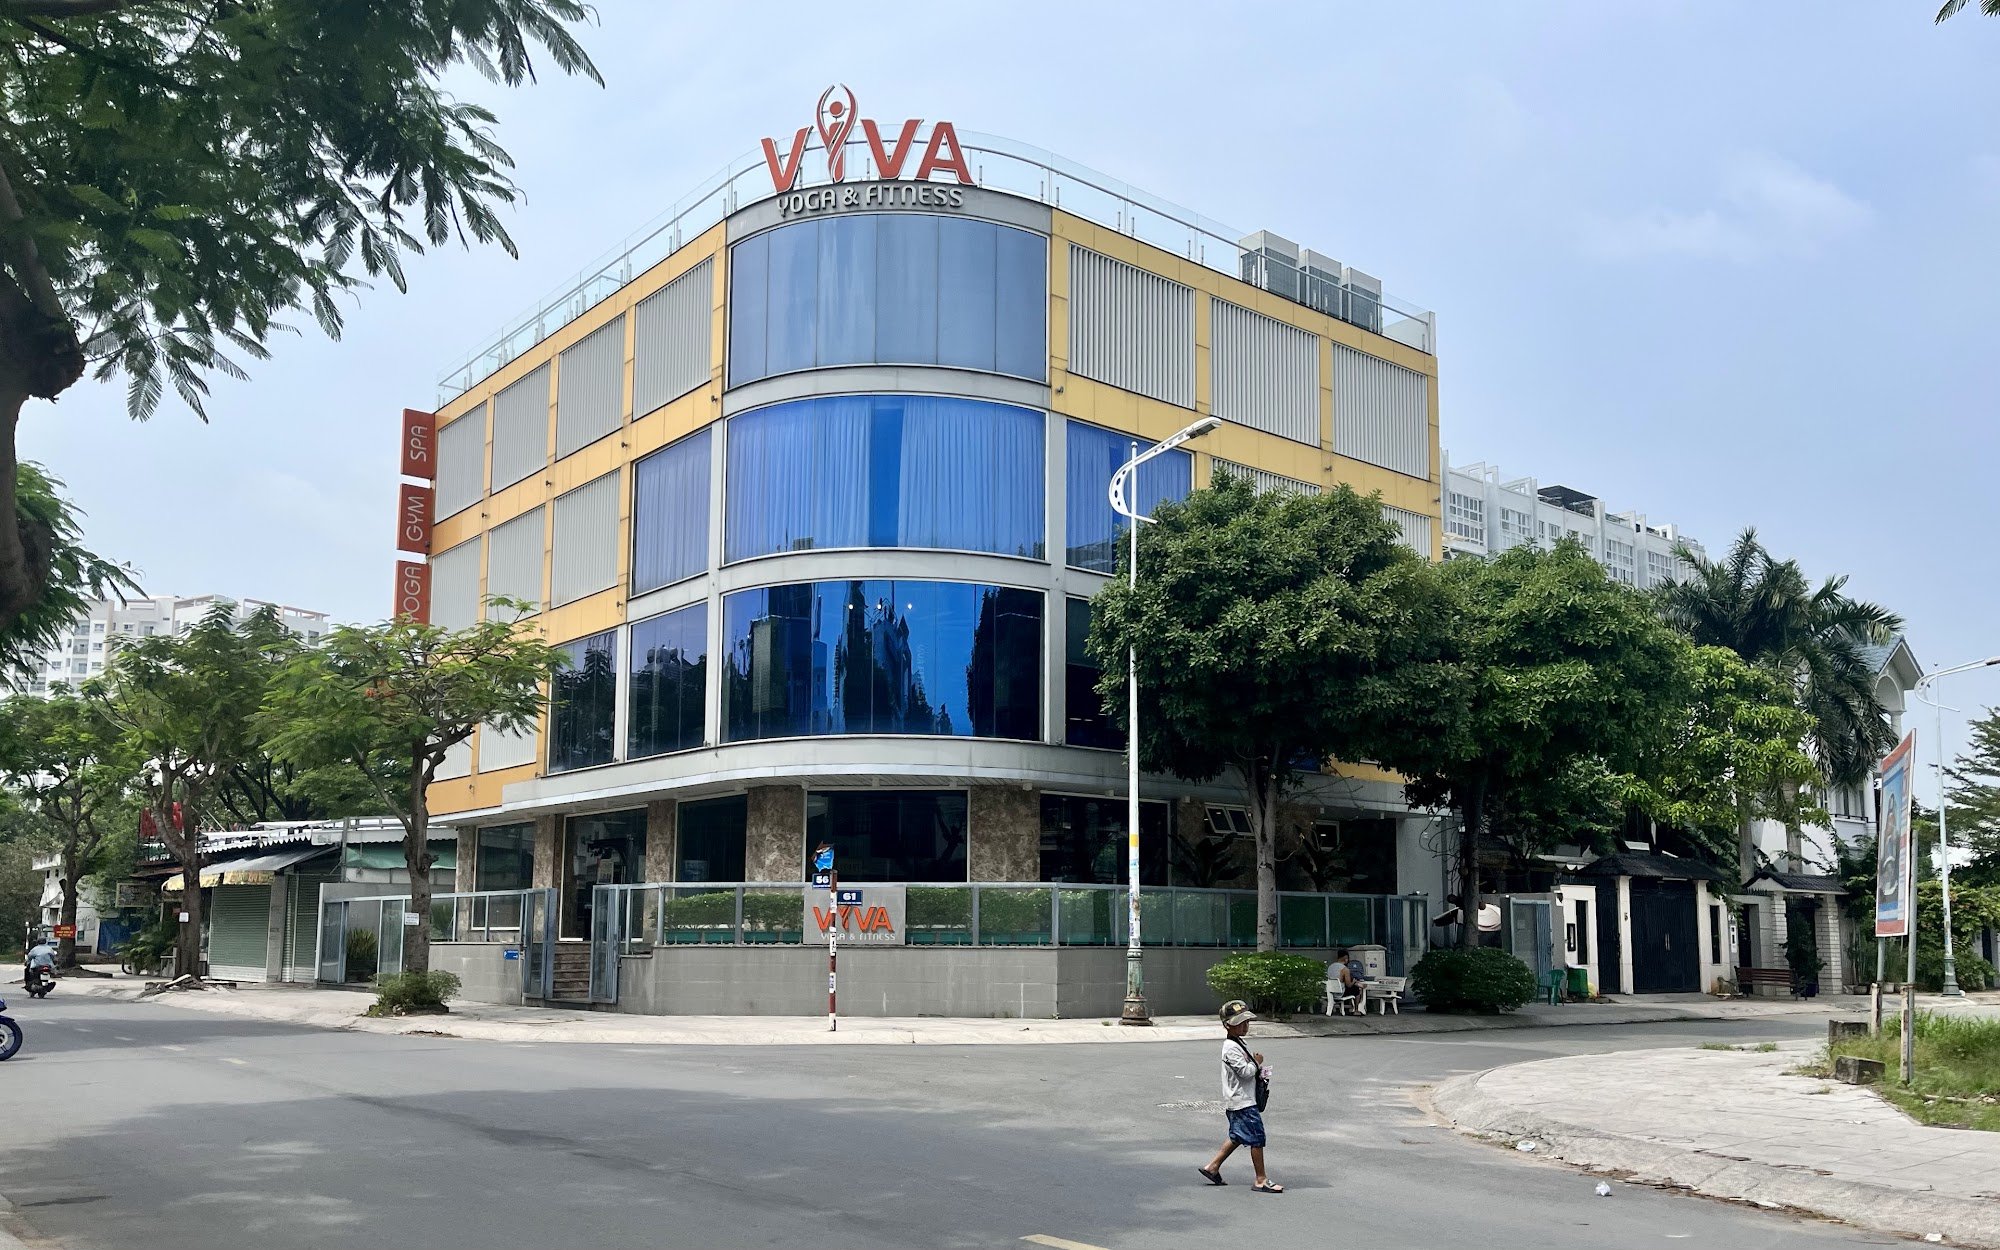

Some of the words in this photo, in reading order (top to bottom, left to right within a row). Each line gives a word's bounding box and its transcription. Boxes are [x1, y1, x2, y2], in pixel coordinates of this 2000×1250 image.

[776, 188, 836, 217] YOGA
[843, 186, 859, 206] &
[866, 184, 964, 207] FITNESS
[410, 425, 428, 462] SPA
[406, 496, 425, 542] GYM
[816, 875, 829, 884] 56
[842, 892, 857, 901] 61
[859, 932, 896, 941] FITNESS
